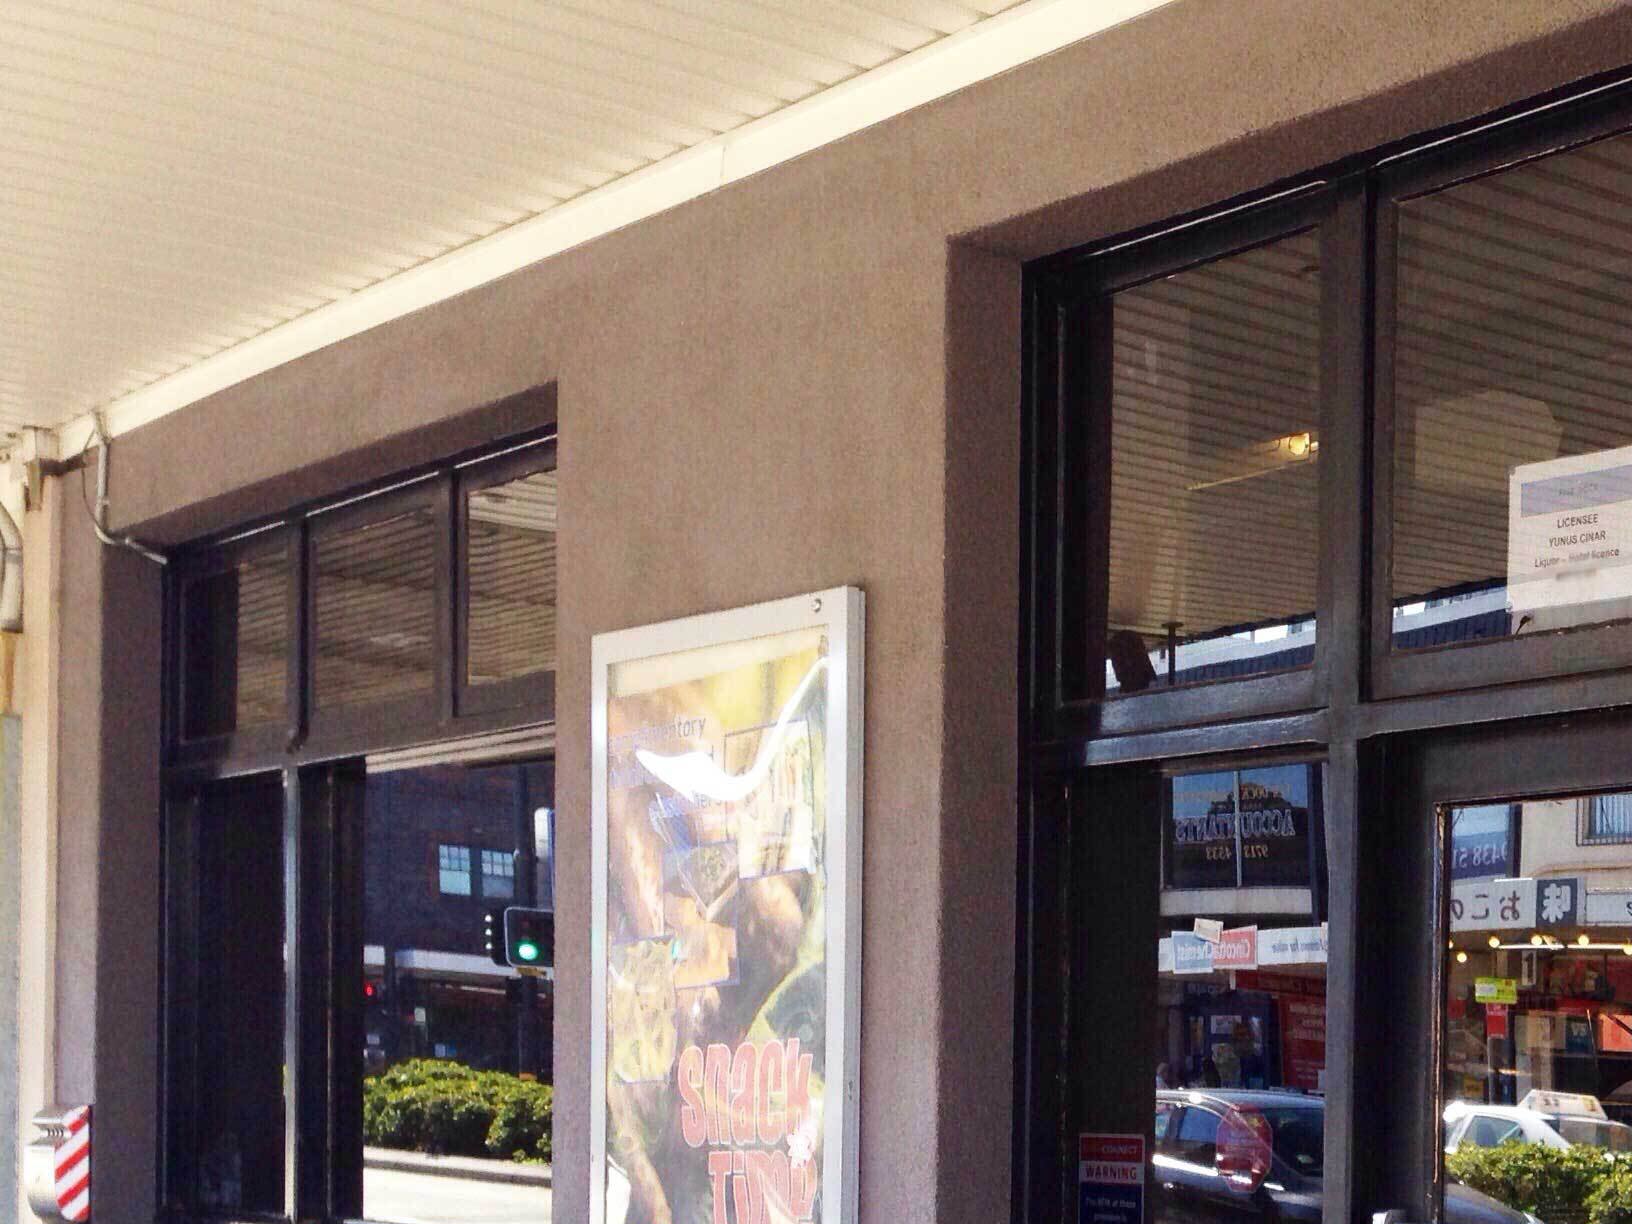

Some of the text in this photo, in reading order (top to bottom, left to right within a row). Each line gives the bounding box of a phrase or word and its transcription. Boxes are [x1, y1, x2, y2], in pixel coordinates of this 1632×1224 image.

[1557, 513, 1599, 529] LICENSEE
[1549, 530, 1607, 548] YUNUS CINAR
[1085, 1164, 1137, 1181] WARNING
